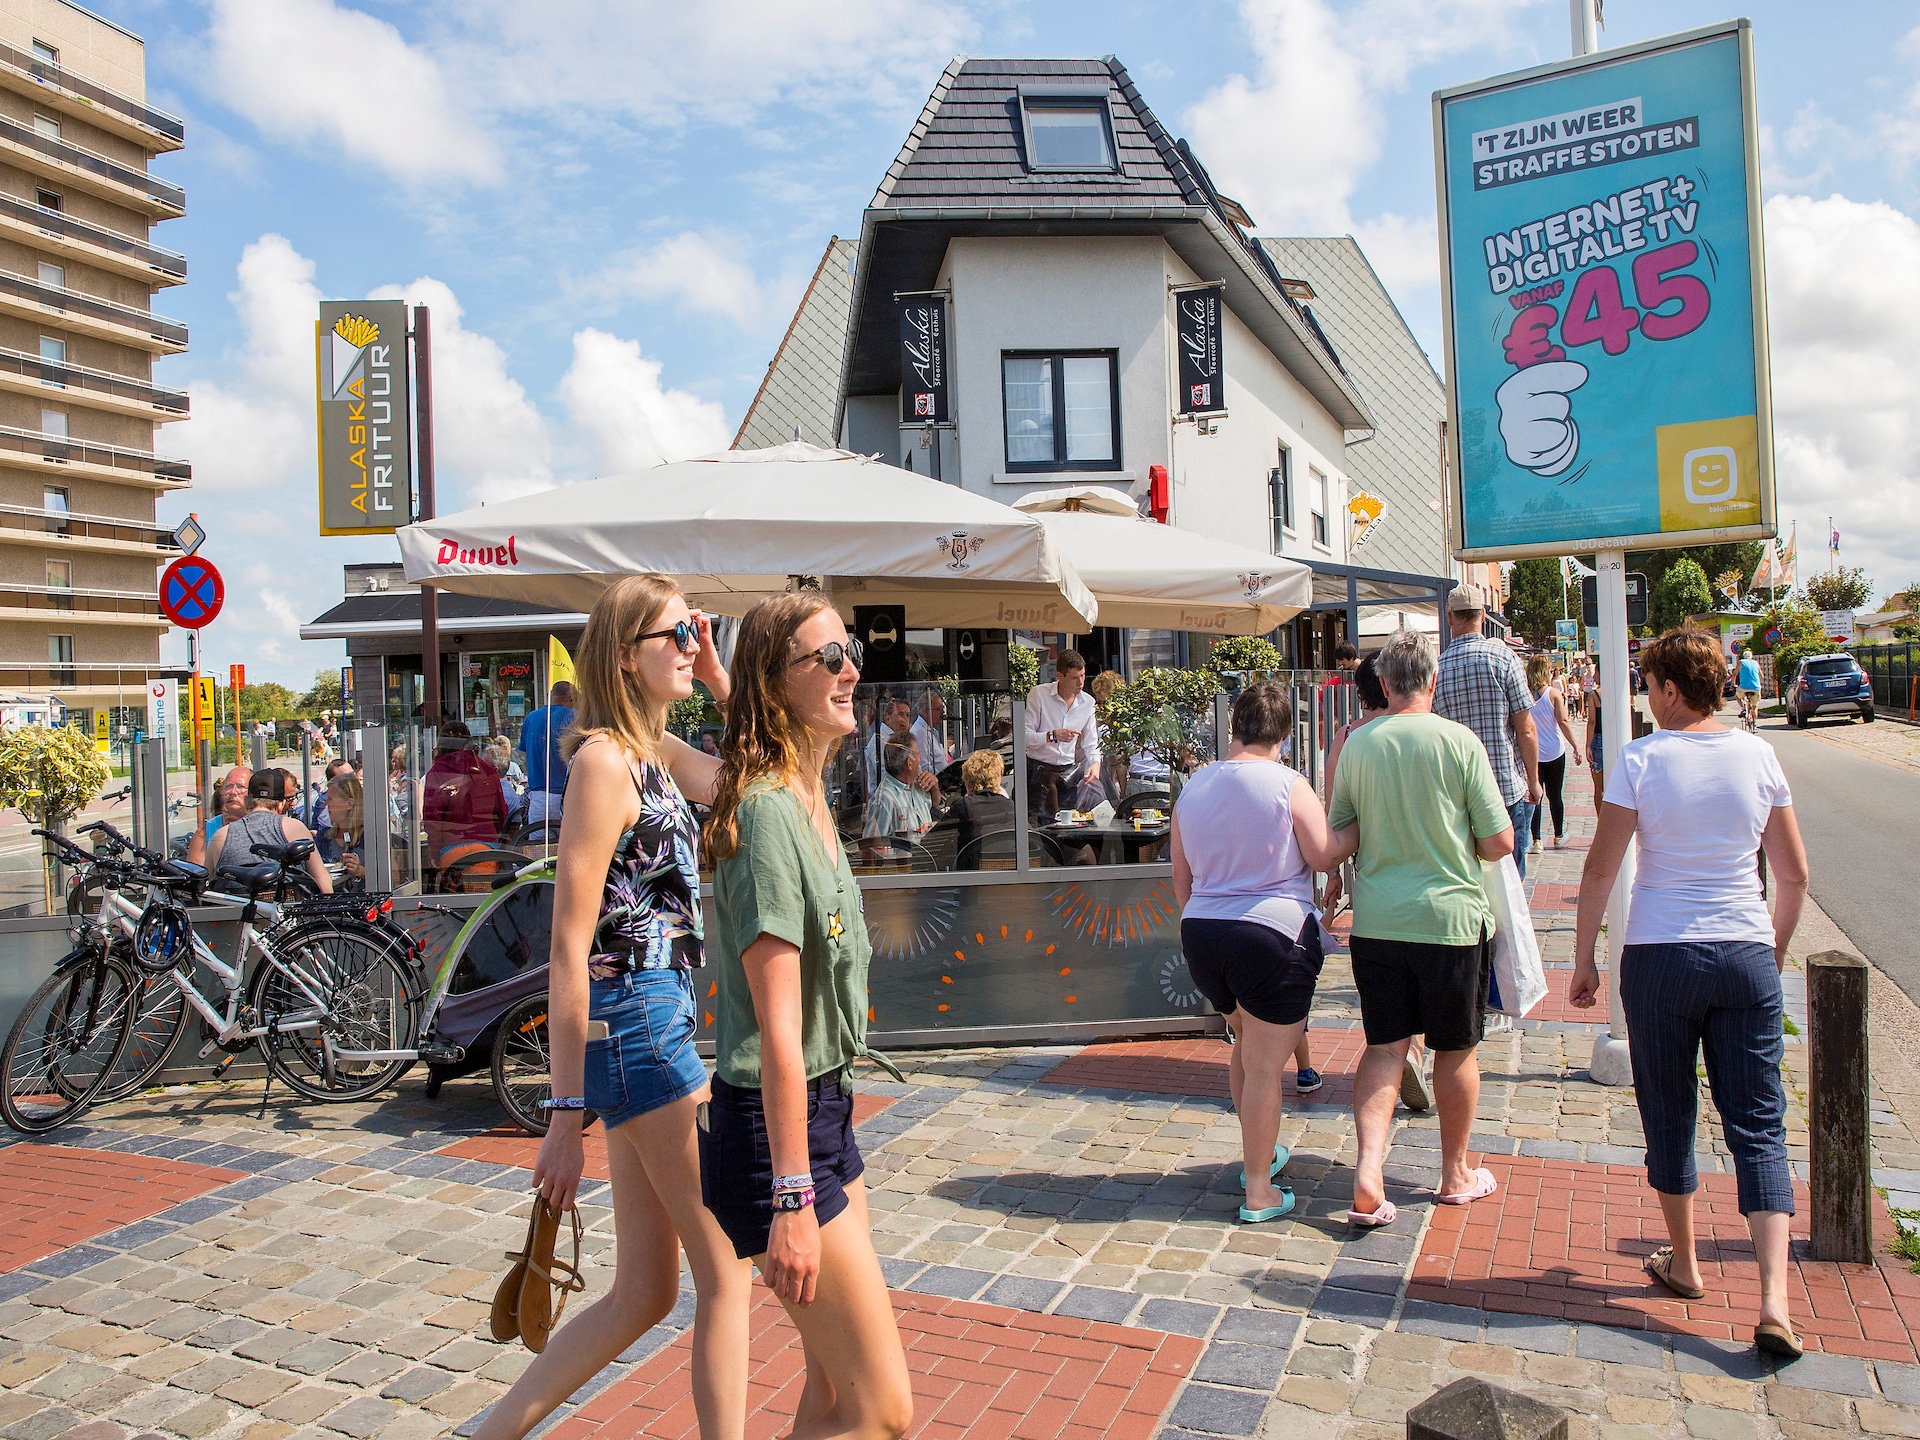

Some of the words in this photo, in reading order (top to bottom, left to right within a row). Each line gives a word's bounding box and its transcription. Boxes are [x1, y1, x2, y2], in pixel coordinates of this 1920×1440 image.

[1477, 134, 1499, 154] 'T
[1503, 121, 1557, 147] ZIJN
[1562, 105, 1637, 137] WEER
[1478, 145, 1587, 185] STRAFFE
[1590, 123, 1694, 161] STOTEN
[1484, 176, 1695, 267] INTERNET+
[1489, 219, 1646, 294] DIGITALE
[1648, 201, 1698, 241] TV
[1508, 280, 1564, 310] VANAF
[904, 307, 933, 389] Alaska
[1180, 298, 1209, 378] Alaska
[348, 376, 368, 514] ALASKA
[371, 344, 394, 511] FRITUUR
[1709, 503, 1749, 513] telenet.be
[436, 534, 519, 566] Duvel
[1572, 537, 1635, 551] JCDecaux
[1611, 562, 1621, 570] 20
[499, 665, 531, 677] OPEN
